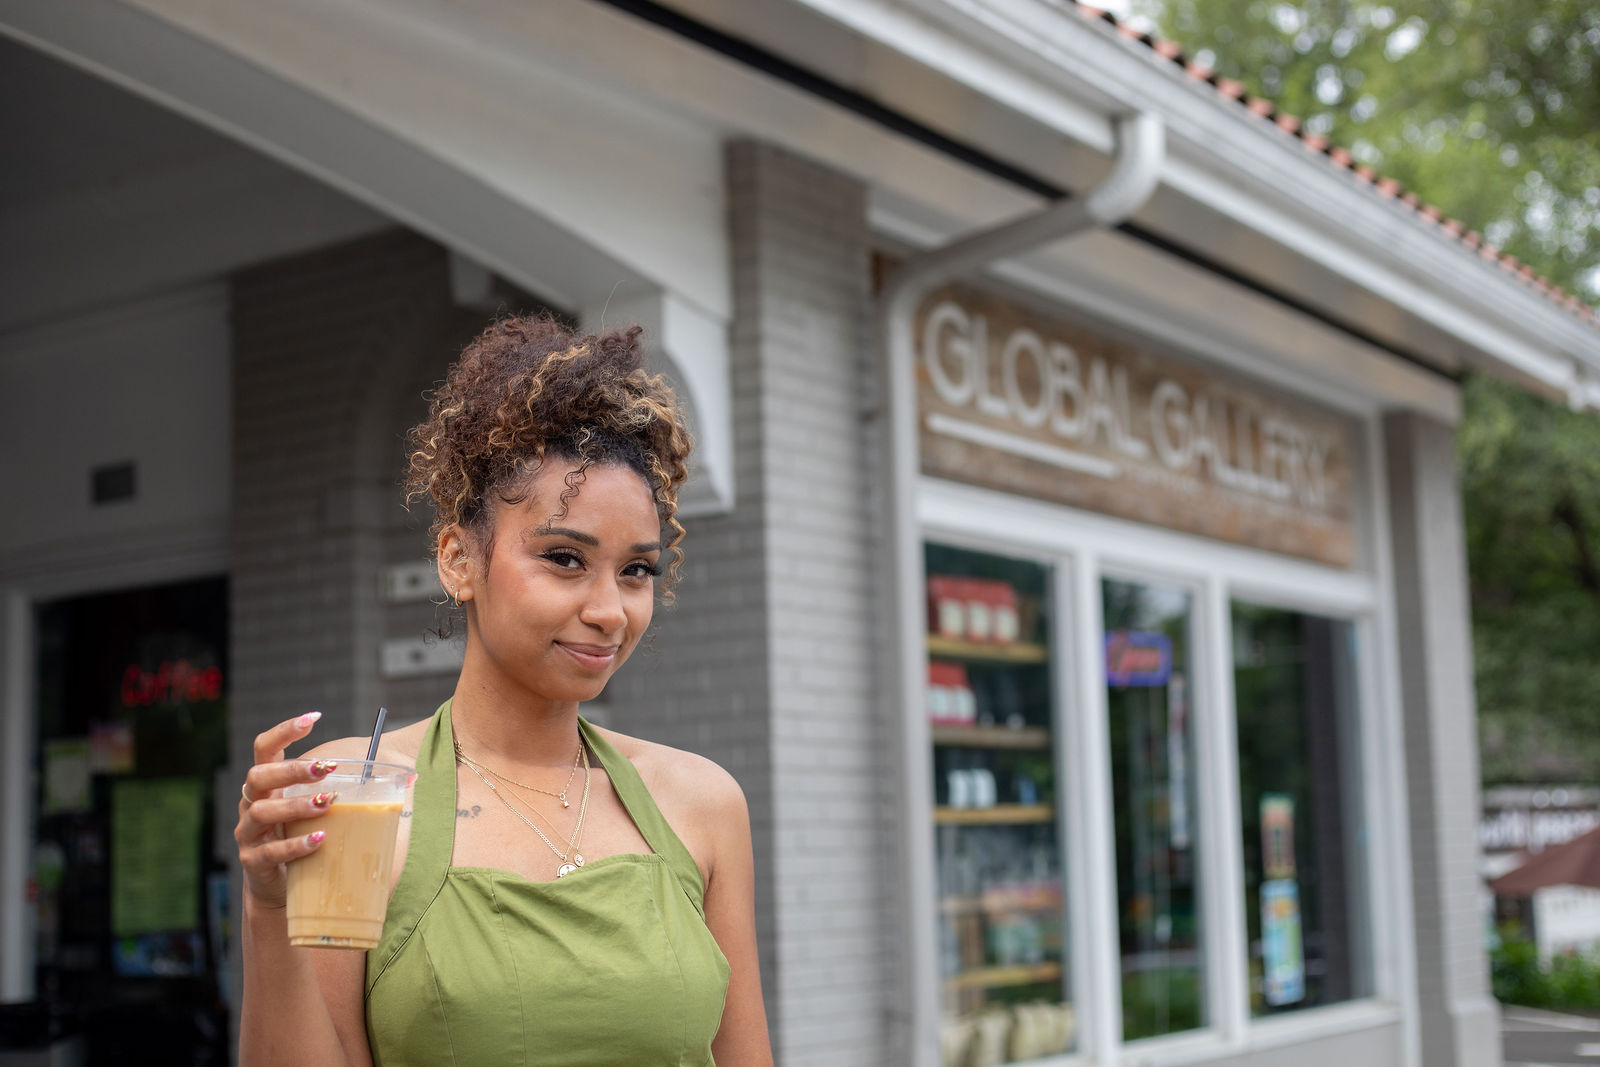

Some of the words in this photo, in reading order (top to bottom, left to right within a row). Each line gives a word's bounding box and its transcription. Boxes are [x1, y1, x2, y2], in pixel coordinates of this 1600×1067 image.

[924, 303, 1148, 459] GLOBAL
[1150, 381, 1330, 507] GALLERY
[122, 659, 223, 706] Coffee
